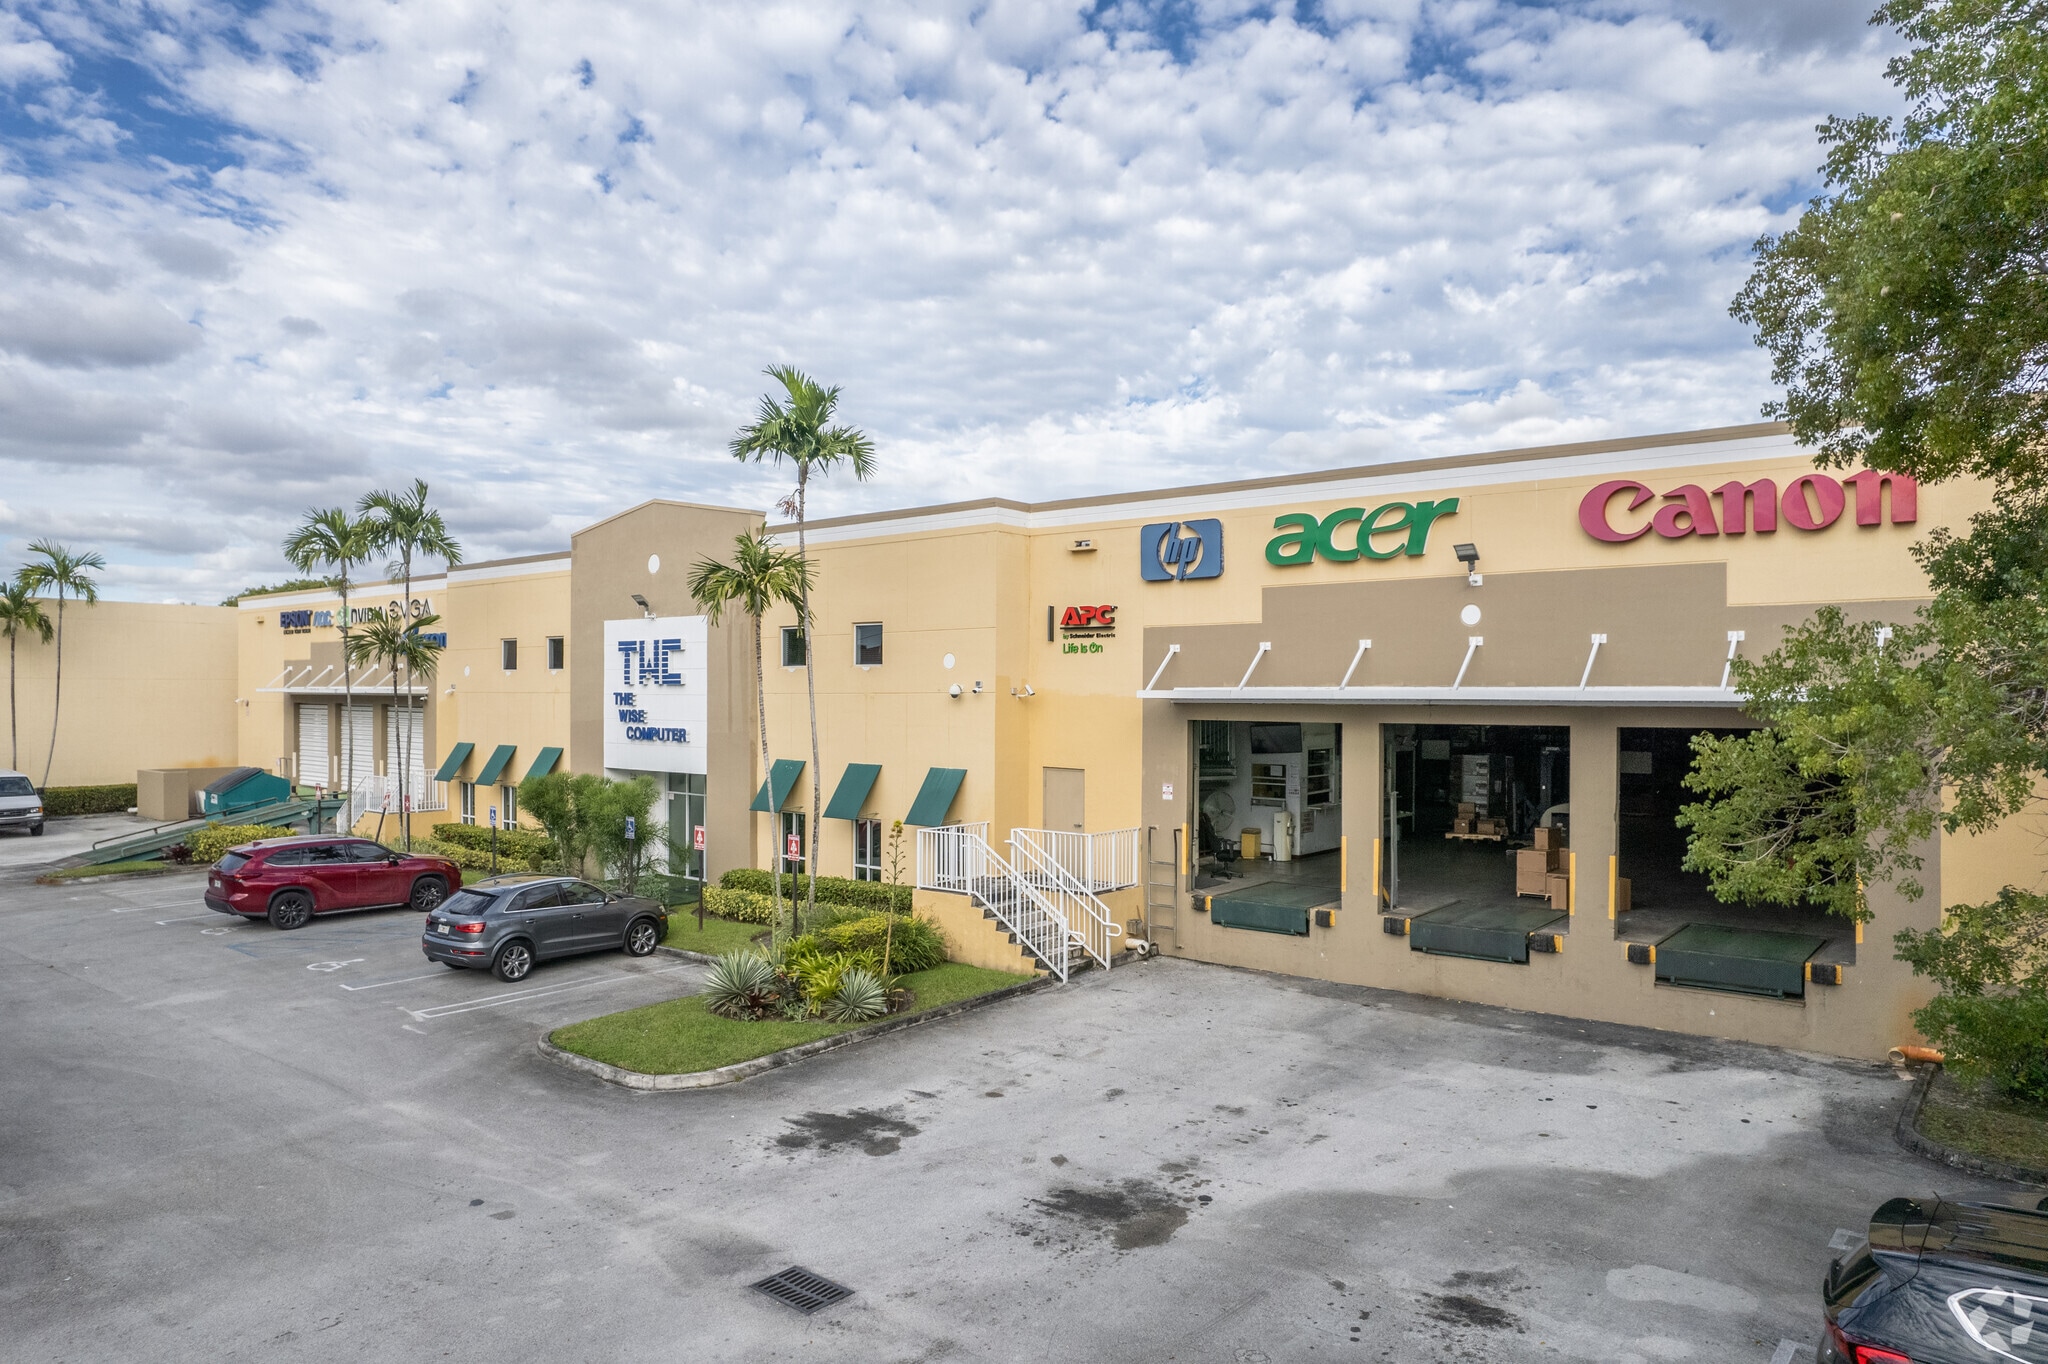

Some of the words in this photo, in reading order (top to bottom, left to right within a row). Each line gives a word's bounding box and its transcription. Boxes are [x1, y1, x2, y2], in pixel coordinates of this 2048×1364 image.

[1578, 469, 1917, 542] Canon
[1265, 497, 1460, 566] acer
[1163, 522, 1201, 580] hp
[280, 610, 310, 627] EPSON
[1060, 605, 1114, 625] APC
[1063, 643, 1079, 654] Life
[1081, 643, 1088, 653] Is
[1089, 642, 1104, 653] On
[618, 638, 682, 685] TWC
[613, 692, 634, 706] THE
[619, 709, 645, 723] WISE
[626, 726, 687, 743] COMPUTER
